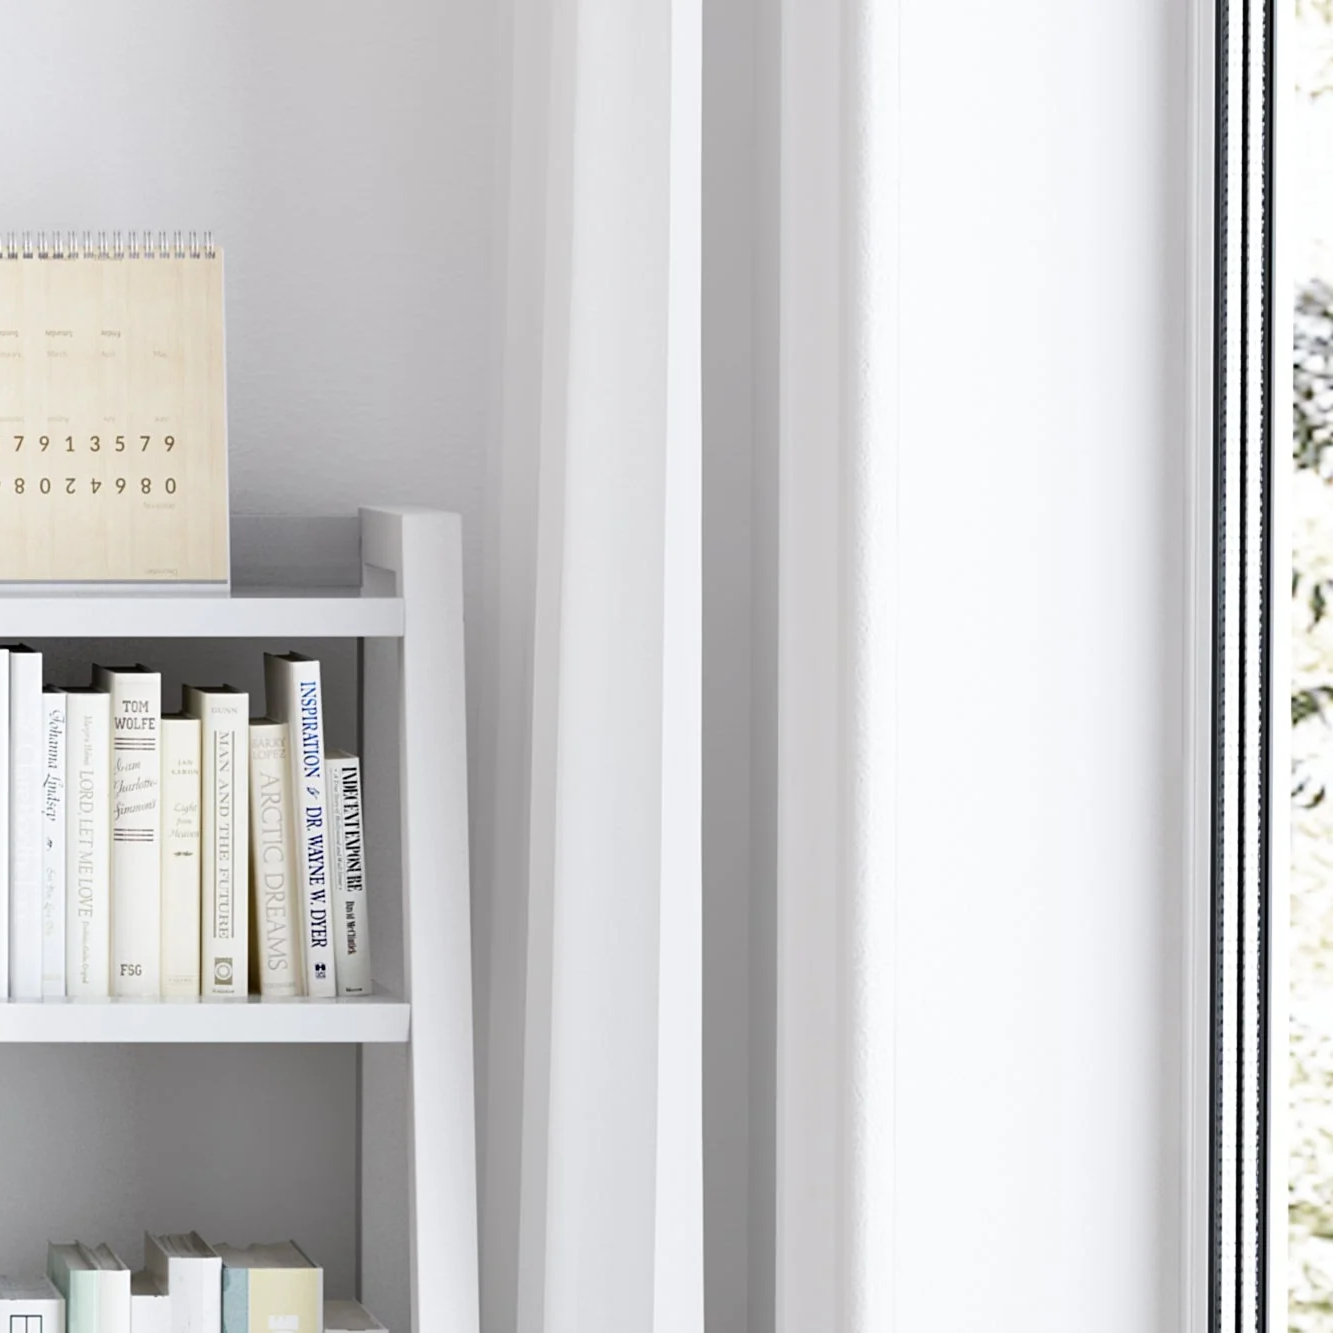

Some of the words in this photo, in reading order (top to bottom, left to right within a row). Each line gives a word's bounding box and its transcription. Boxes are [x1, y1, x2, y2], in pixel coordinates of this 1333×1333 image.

[14, 436, 24, 451] 7
[39, 436, 49, 451] 9
[66, 436, 74, 452] 1
[90, 436, 100, 452] 3
[116, 436, 125, 452] 5
[140, 436, 150, 451] 7
[165, 436, 174, 452] 9
[113, 717, 155, 729] WOLFE
[122, 700, 148, 712] TOM
[48, 710, 65, 768] Johanna
[301, 682, 320, 777] INSPIRATION
[220, 733, 229, 771] MAN
[41, 773, 60, 821] Lindsey
[78, 771, 93, 814] LORD,
[218, 779, 230, 817] AND
[342, 768, 359, 828] INDECENT
[79, 819, 93, 848] LET
[261, 768, 285, 863] ARCTIC
[305, 807, 323, 831] DR.
[219, 824, 229, 860] THE
[308, 835, 324, 885] WAYNE
[345, 831, 362, 891] EXPOSURE
[78, 851, 93, 874] ME
[78, 879, 93, 917] LOVE
[219, 869, 229, 938] FUTURE
[311, 889, 325, 903] W.
[265, 873, 288, 970] DREAMS
[311, 910, 327, 947] DYER
[120, 964, 141, 976] FSG
